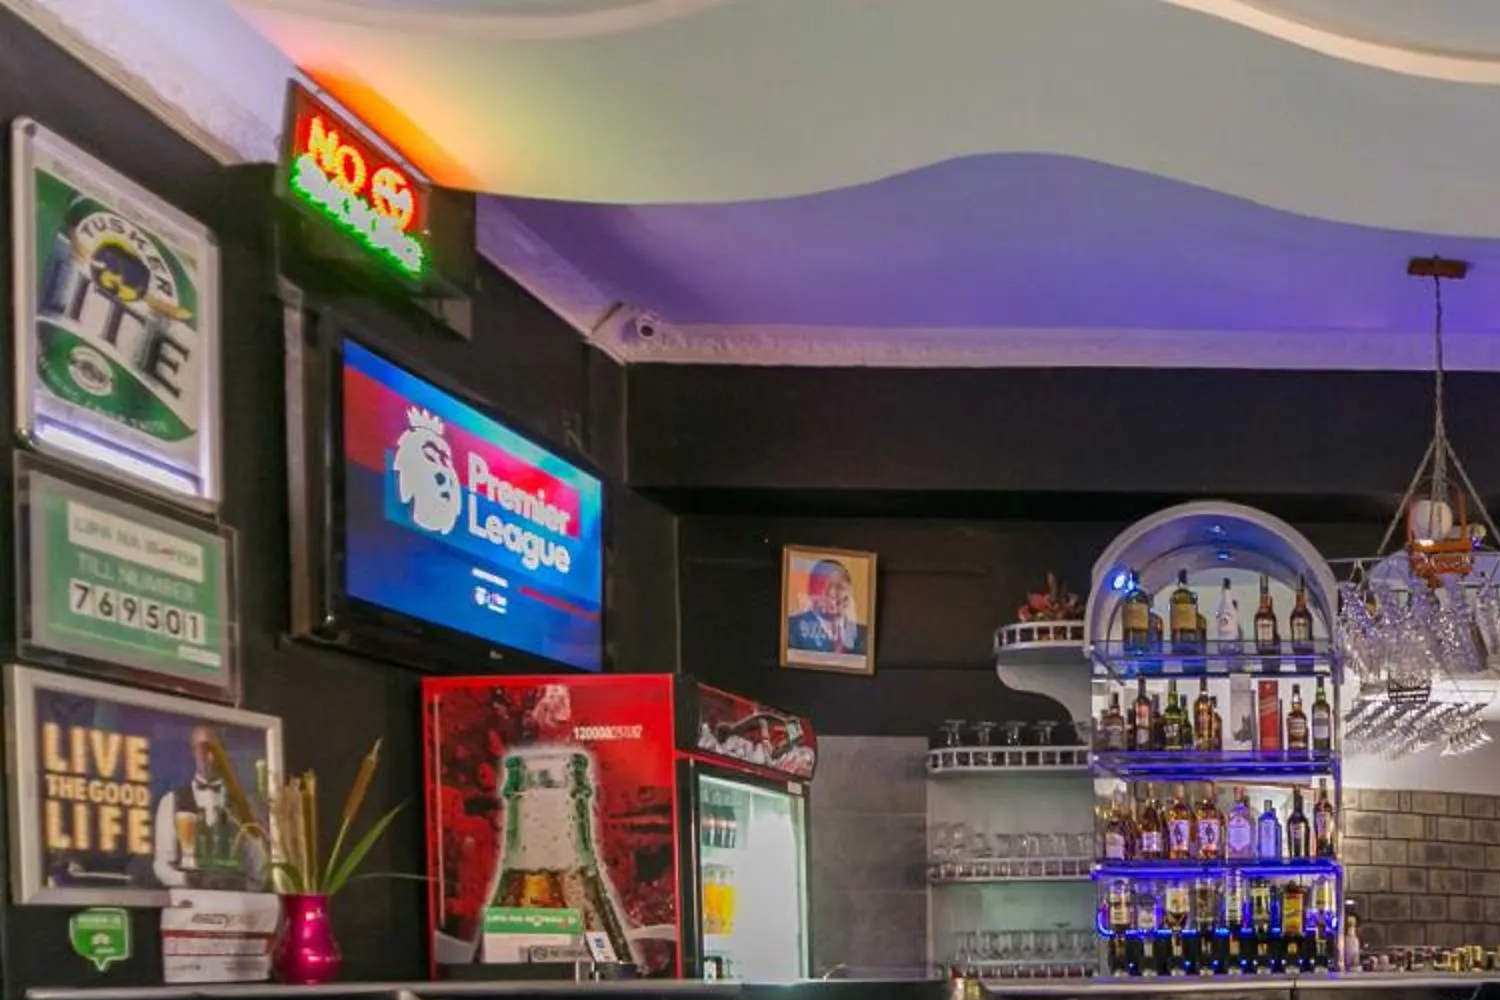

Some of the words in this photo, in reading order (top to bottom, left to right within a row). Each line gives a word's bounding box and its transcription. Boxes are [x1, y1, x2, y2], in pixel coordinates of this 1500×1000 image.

[308, 115, 367, 194] NO
[80, 217, 174, 297] TUSKER
[38, 240, 191, 399] LITE
[468, 451, 571, 536] Premier
[468, 494, 571, 573] League
[73, 583, 199, 640] 769501
[42, 721, 150, 784] LIVE
[45, 773, 87, 802] THE
[88, 780, 150, 807] GOOD
[46, 799, 152, 855] LIFE
